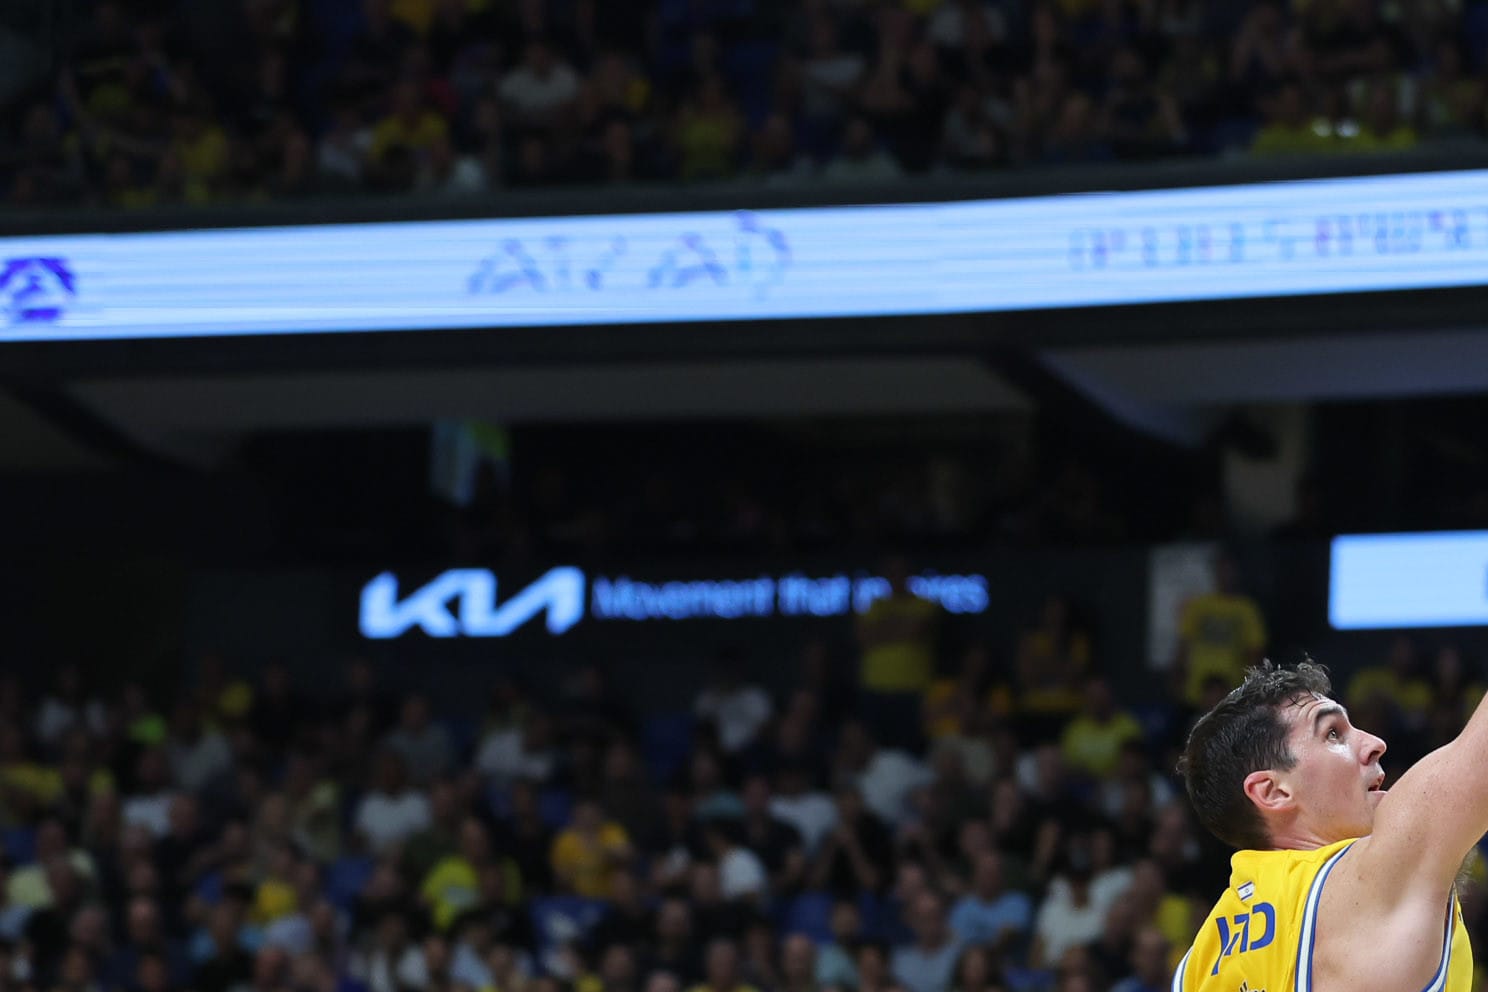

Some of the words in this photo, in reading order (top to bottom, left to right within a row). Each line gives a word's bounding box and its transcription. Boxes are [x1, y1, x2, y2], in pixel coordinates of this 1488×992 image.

[592, 575, 774, 620] Movement
[779, 572, 850, 617] that
[1211, 902, 1276, 976] כהן
